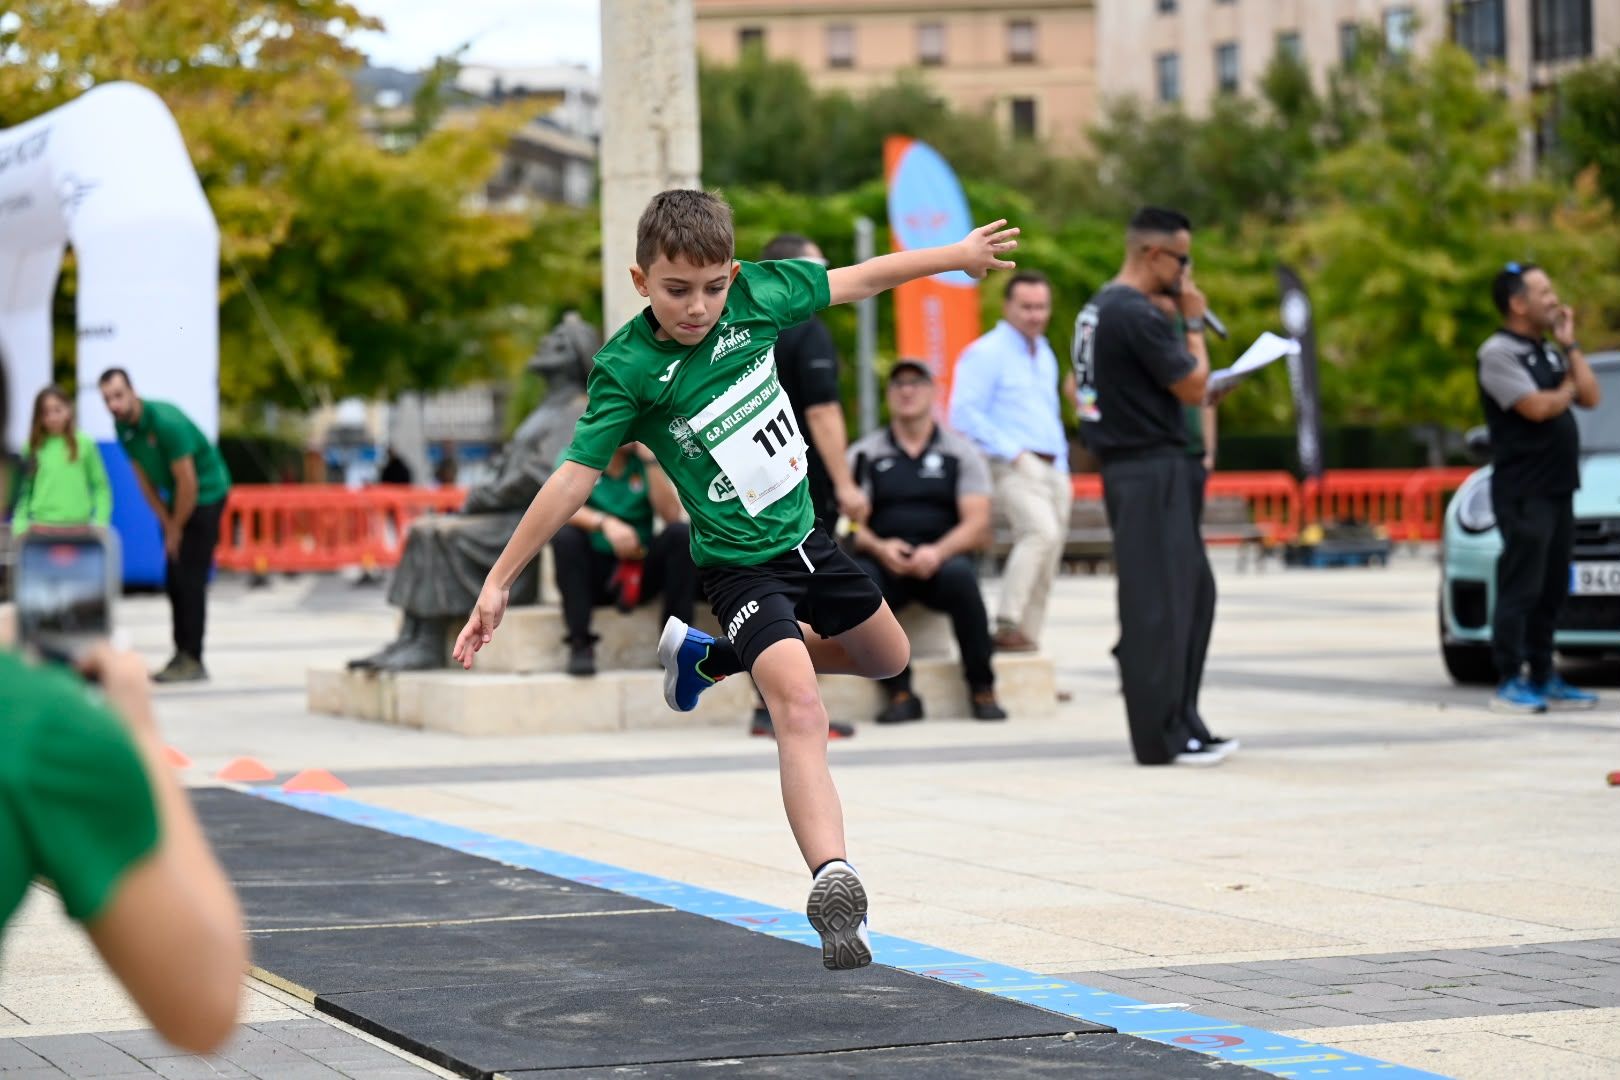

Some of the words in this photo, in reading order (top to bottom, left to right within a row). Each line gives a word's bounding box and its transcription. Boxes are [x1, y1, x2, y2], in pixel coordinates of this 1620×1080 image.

[714, 328, 751, 354] SPRINT
[706, 426, 724, 442] G.P.
[721, 395, 763, 431] ATLETISMO
[760, 386, 773, 401] EN
[752, 409, 795, 458] 111
[727, 600, 760, 645] SONIC
